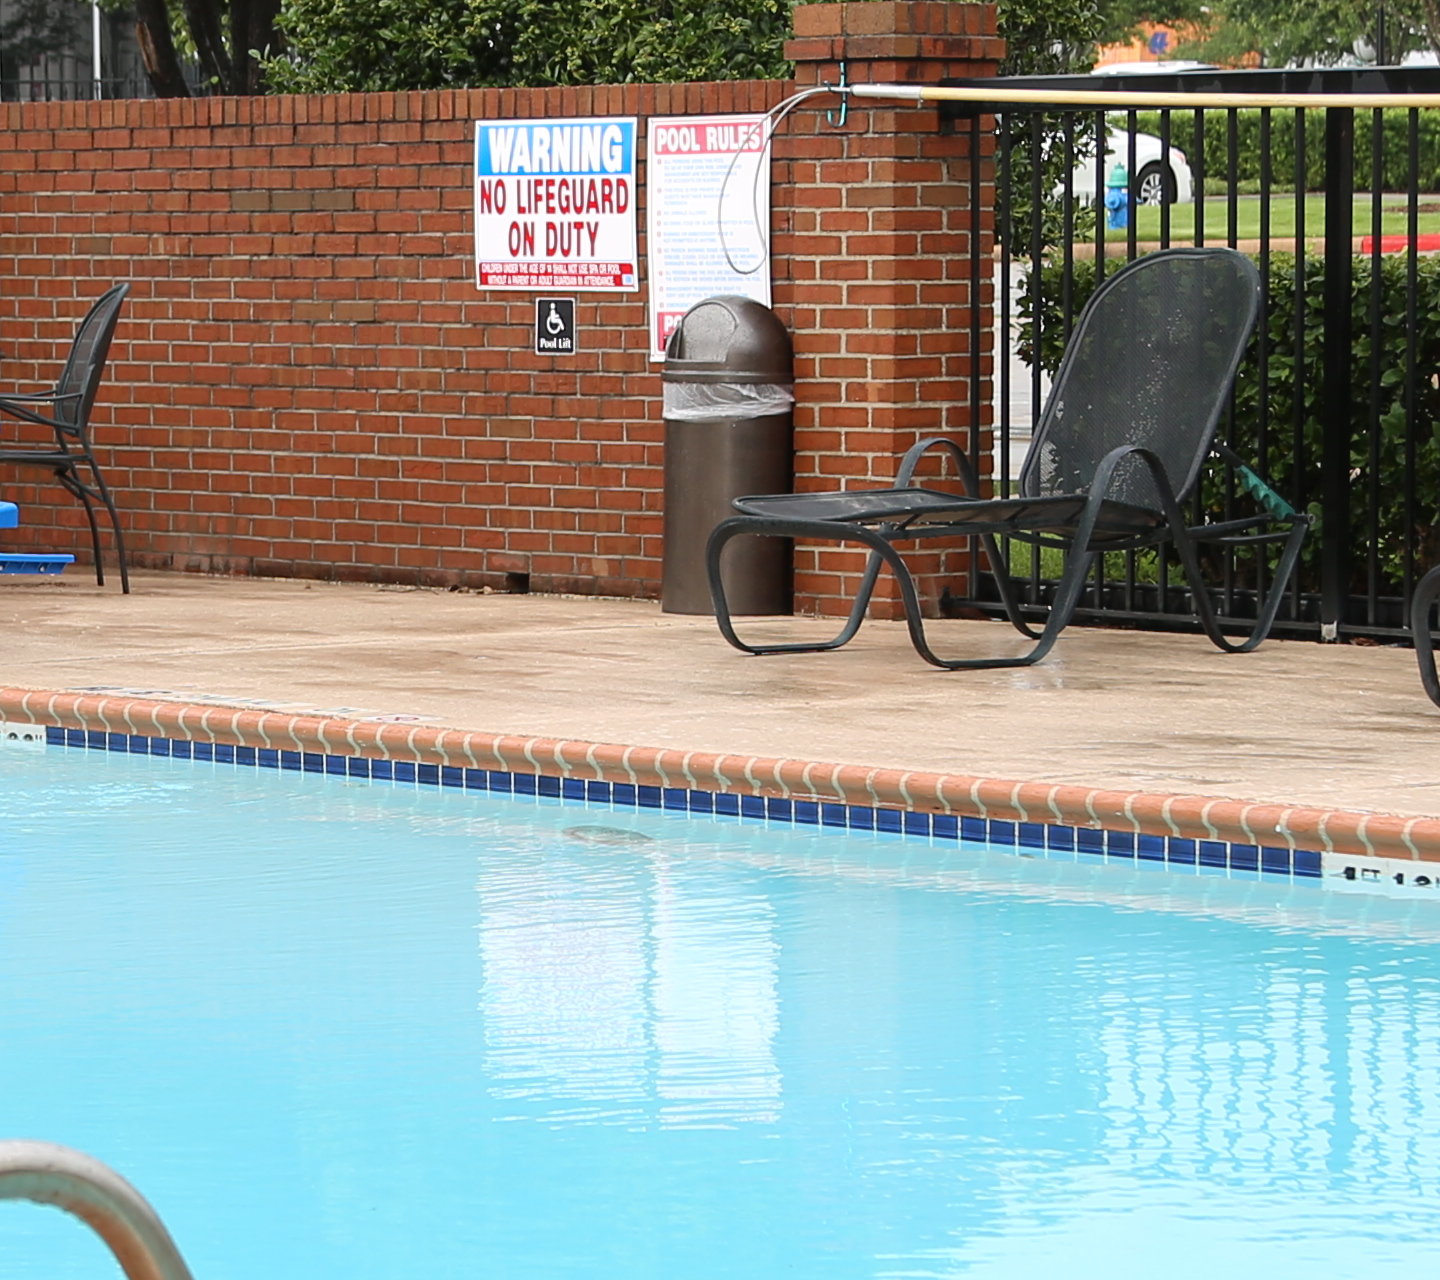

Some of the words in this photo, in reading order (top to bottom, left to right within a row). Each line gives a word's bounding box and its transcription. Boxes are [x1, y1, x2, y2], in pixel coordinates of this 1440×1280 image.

[487, 124, 623, 174] WARNING
[656, 126, 700, 152] POOL
[706, 125, 760, 151] RULES
[480, 178, 507, 215] NO
[517, 177, 629, 215] LIFEGUARD
[508, 220, 535, 257] ON
[545, 220, 599, 257] DUTY
[540, 337, 556, 348] Pool
[558, 337, 571, 348] Lift
